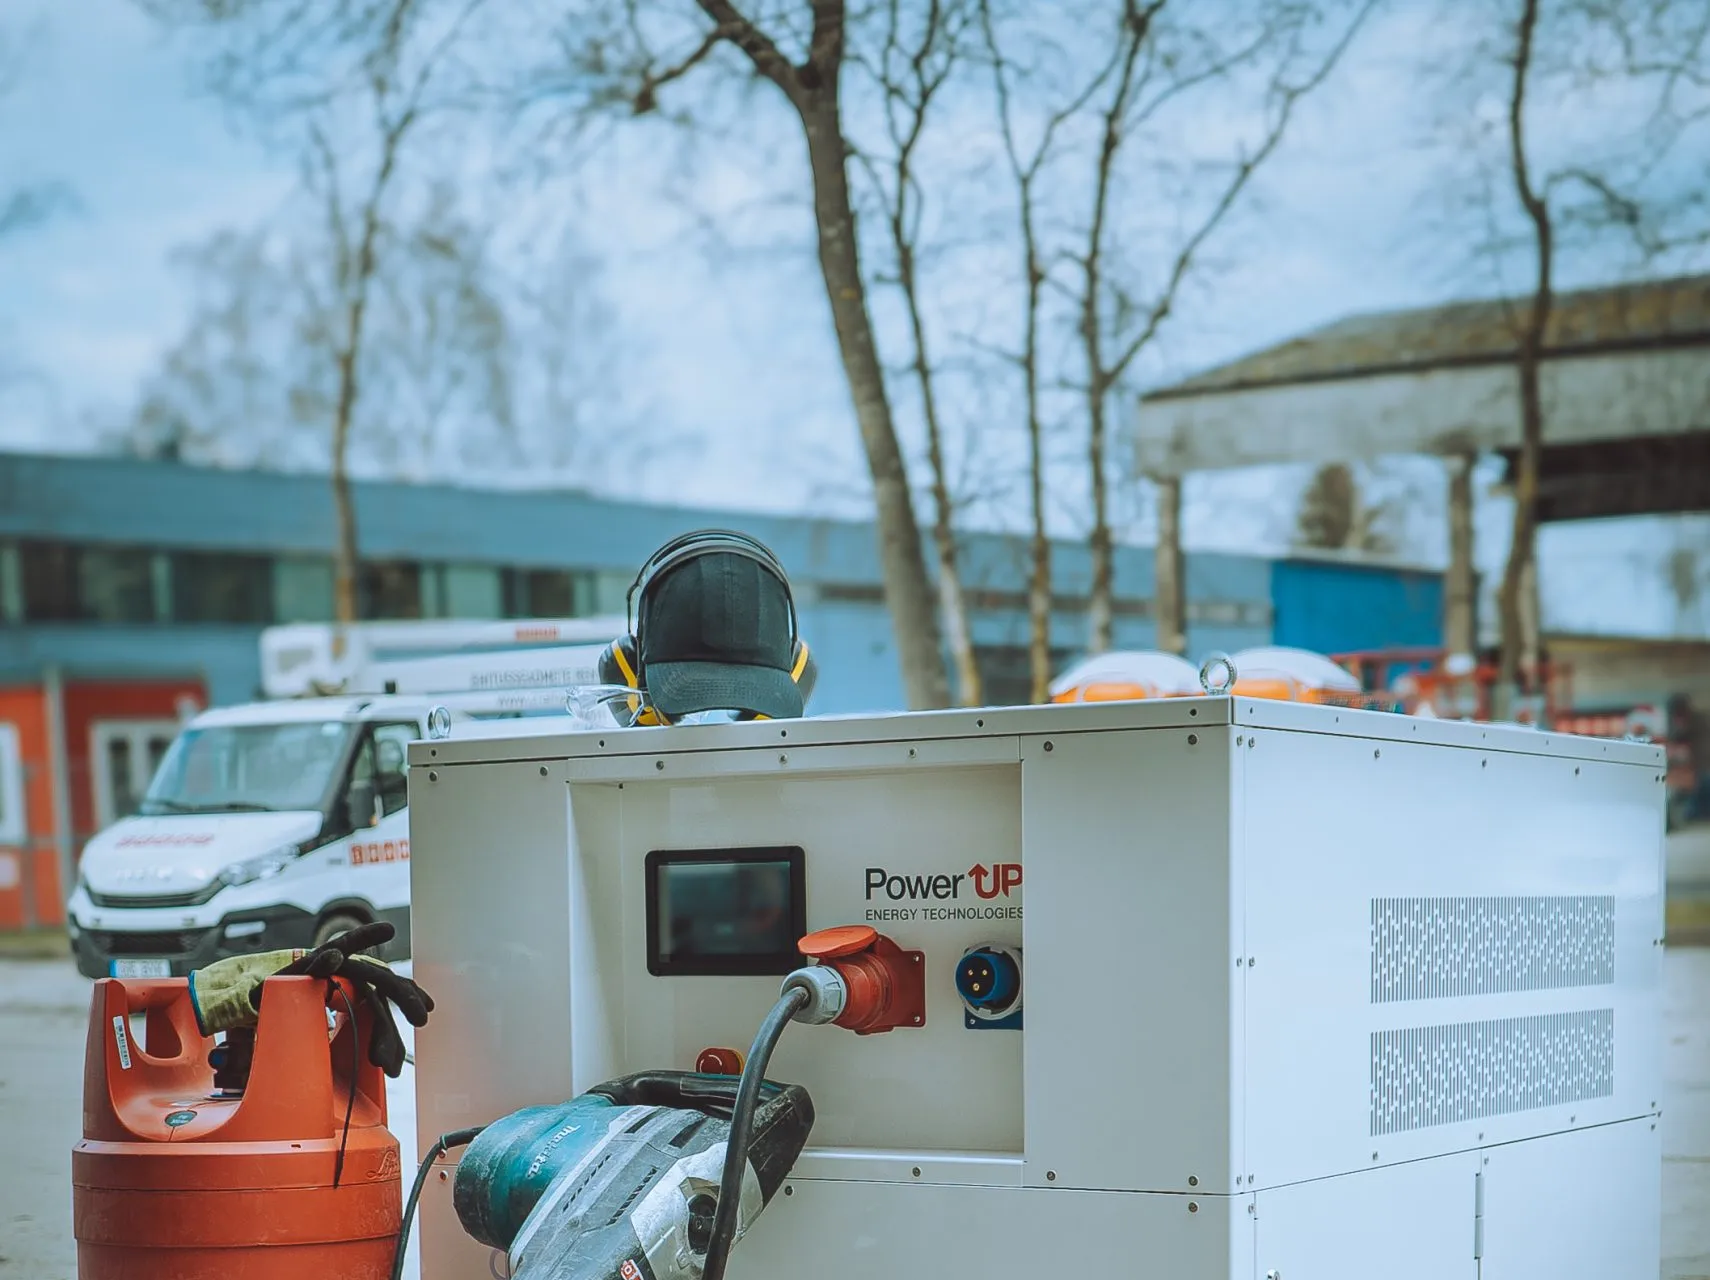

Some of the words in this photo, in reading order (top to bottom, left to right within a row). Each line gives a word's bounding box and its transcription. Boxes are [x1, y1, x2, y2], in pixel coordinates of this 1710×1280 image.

[865, 867, 965, 900] Power
[865, 908, 918, 921] ENERGY
[922, 907, 1023, 920] TECHNOLOGIES
